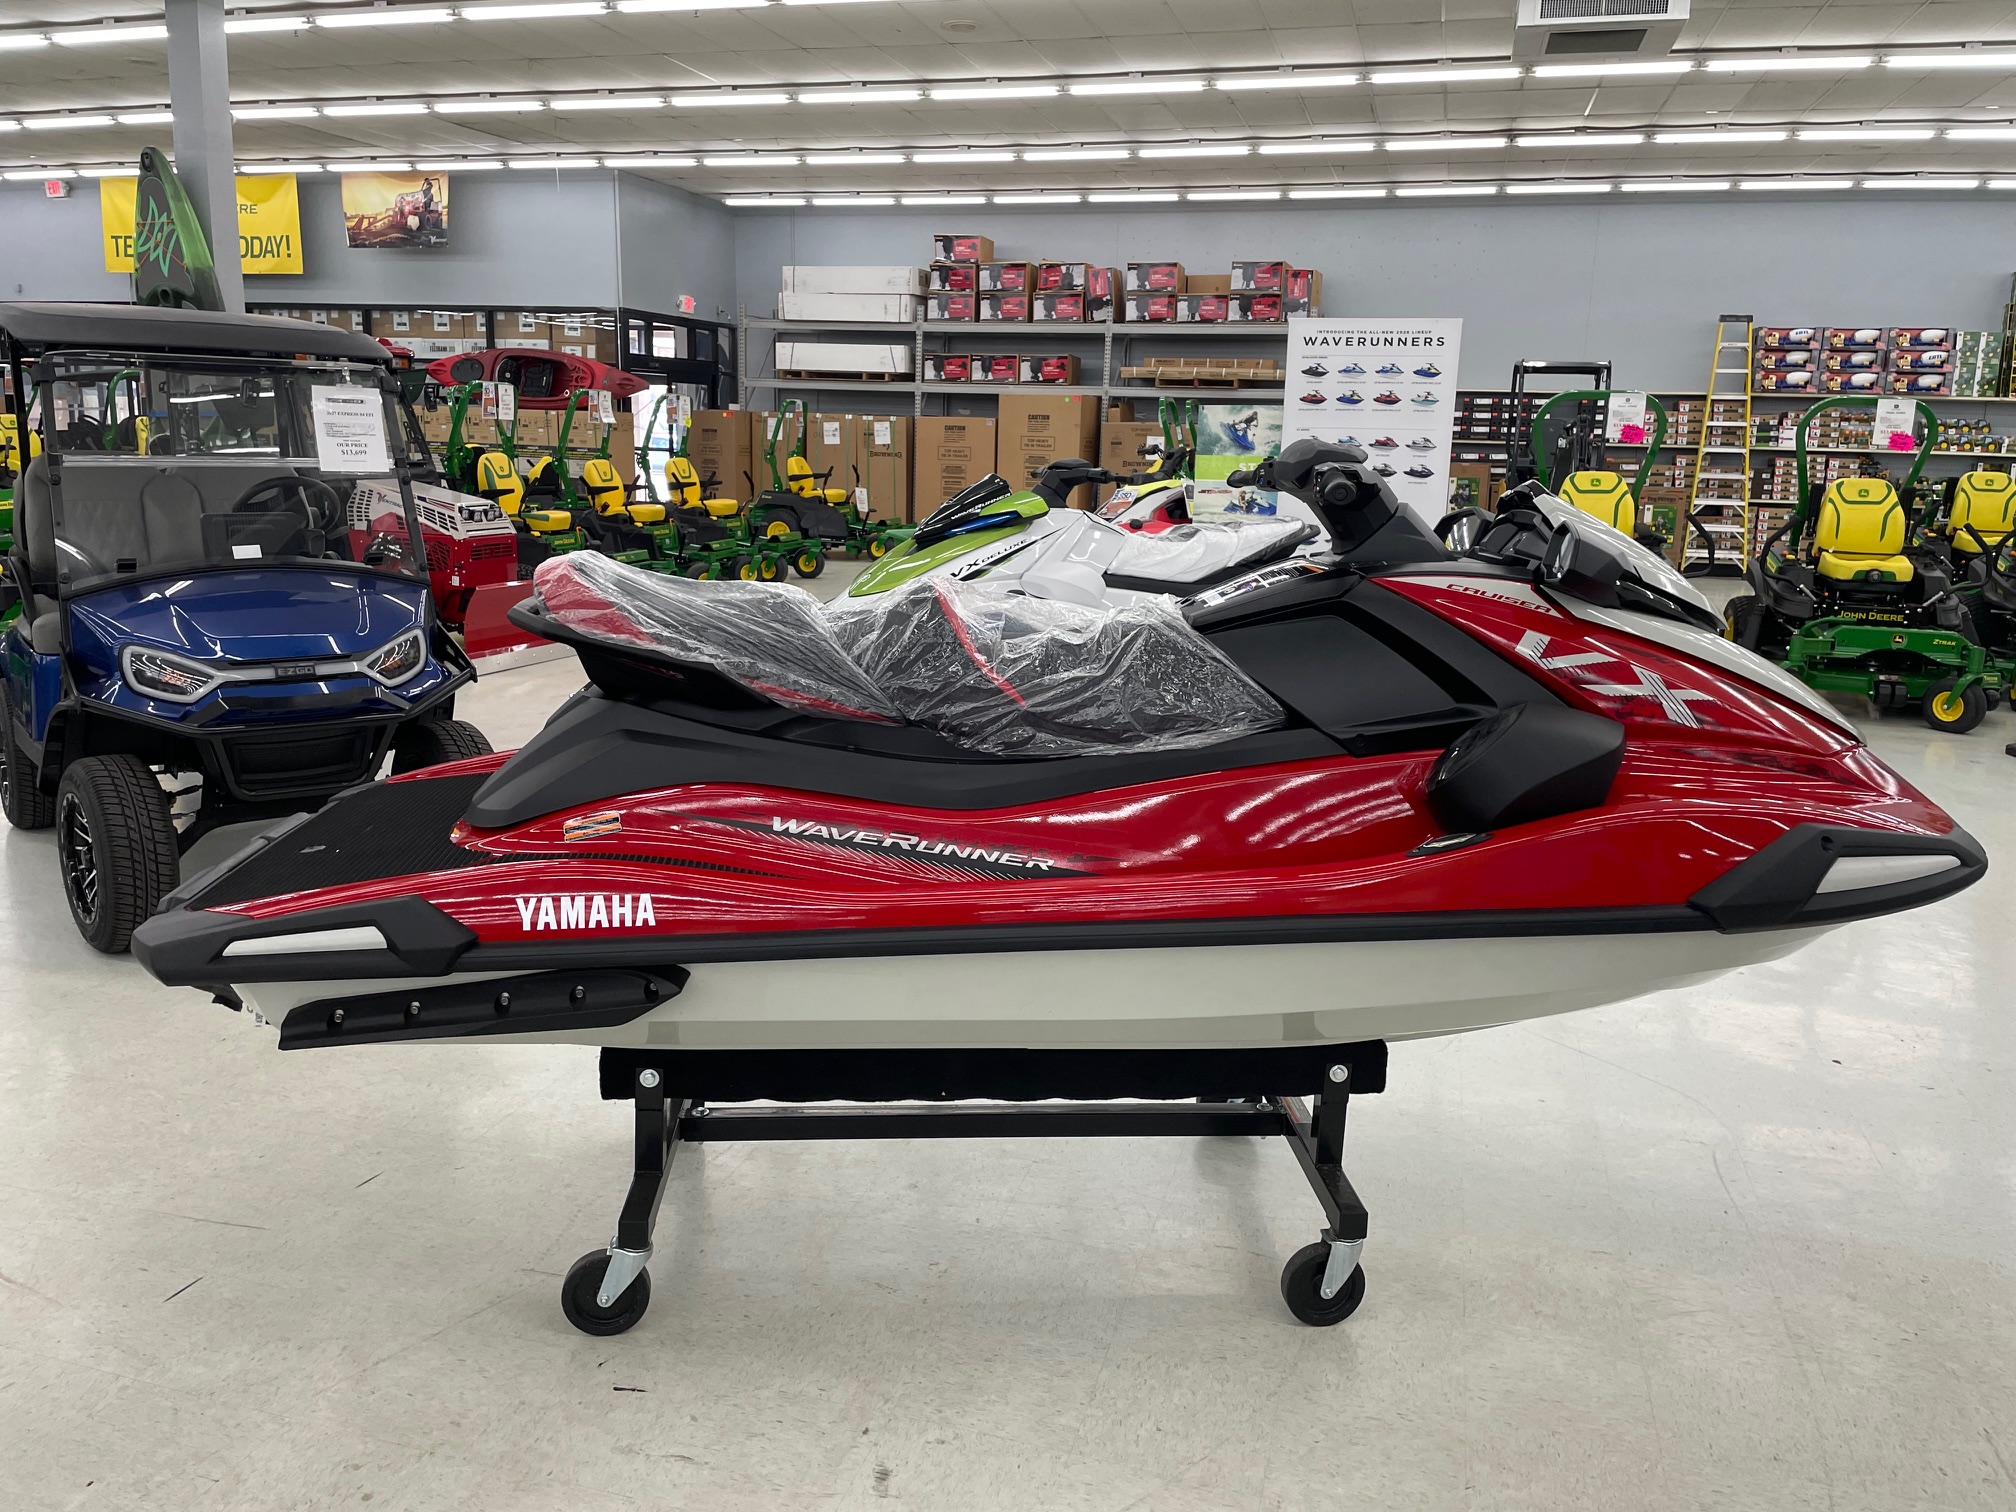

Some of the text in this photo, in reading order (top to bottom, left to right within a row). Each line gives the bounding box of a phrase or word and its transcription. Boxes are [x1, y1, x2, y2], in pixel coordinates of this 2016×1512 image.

[1303, 336, 1446, 347] WAVERUNNERS
[950, 538, 1028, 578] VX DELUXE
[1446, 583, 1552, 613] CRUISER
[1837, 610, 1904, 622] JOHN DEERE
[1933, 638, 1956, 646] ZTRAK
[277, 666, 314, 676] EZGO
[1515, 629, 1716, 729] VX
[771, 815, 1055, 872] WAVERUNNER
[515, 893, 656, 931] YAMAHA
